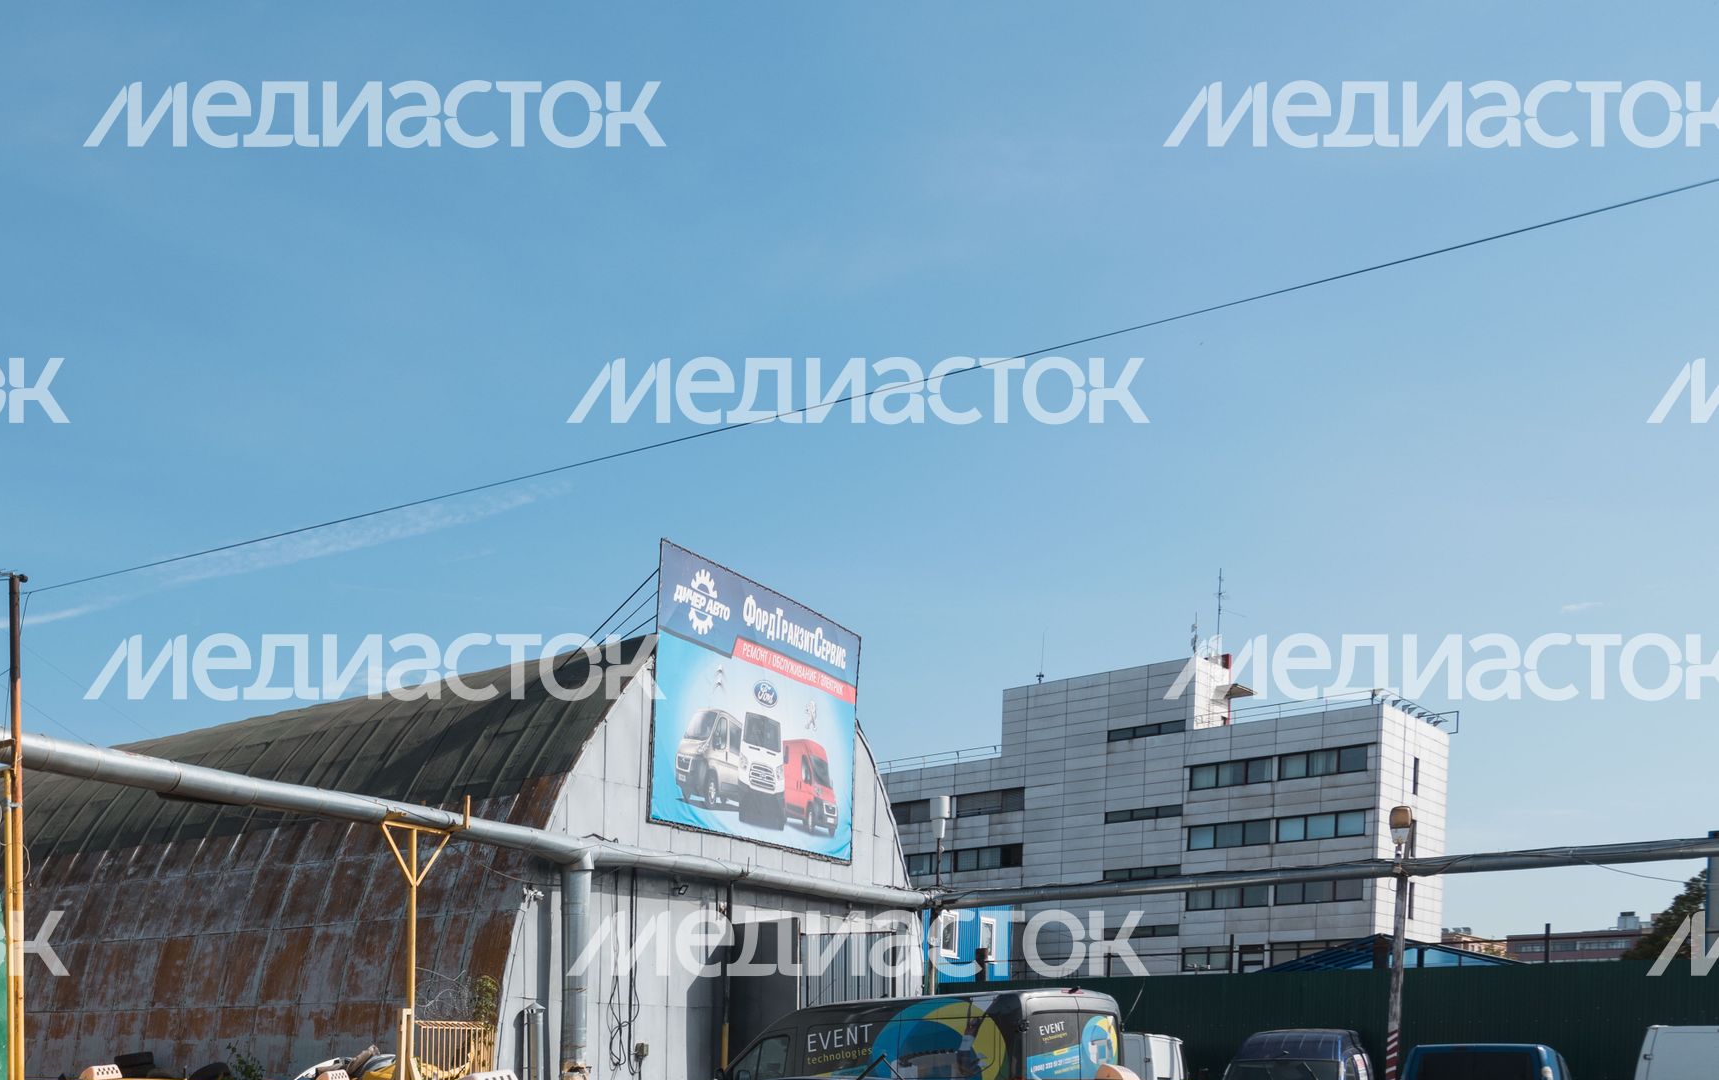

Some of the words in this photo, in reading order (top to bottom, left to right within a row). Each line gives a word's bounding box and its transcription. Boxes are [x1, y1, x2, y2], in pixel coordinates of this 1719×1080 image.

[706, 600, 731, 621] АВТО
[742, 643, 768, 661] РЕМОНТ
[757, 683, 776, 706] Ford
[807, 1023, 873, 1052] EVENT
[1039, 1021, 1065, 1036] EVENT
[807, 1047, 873, 1065] technologies
